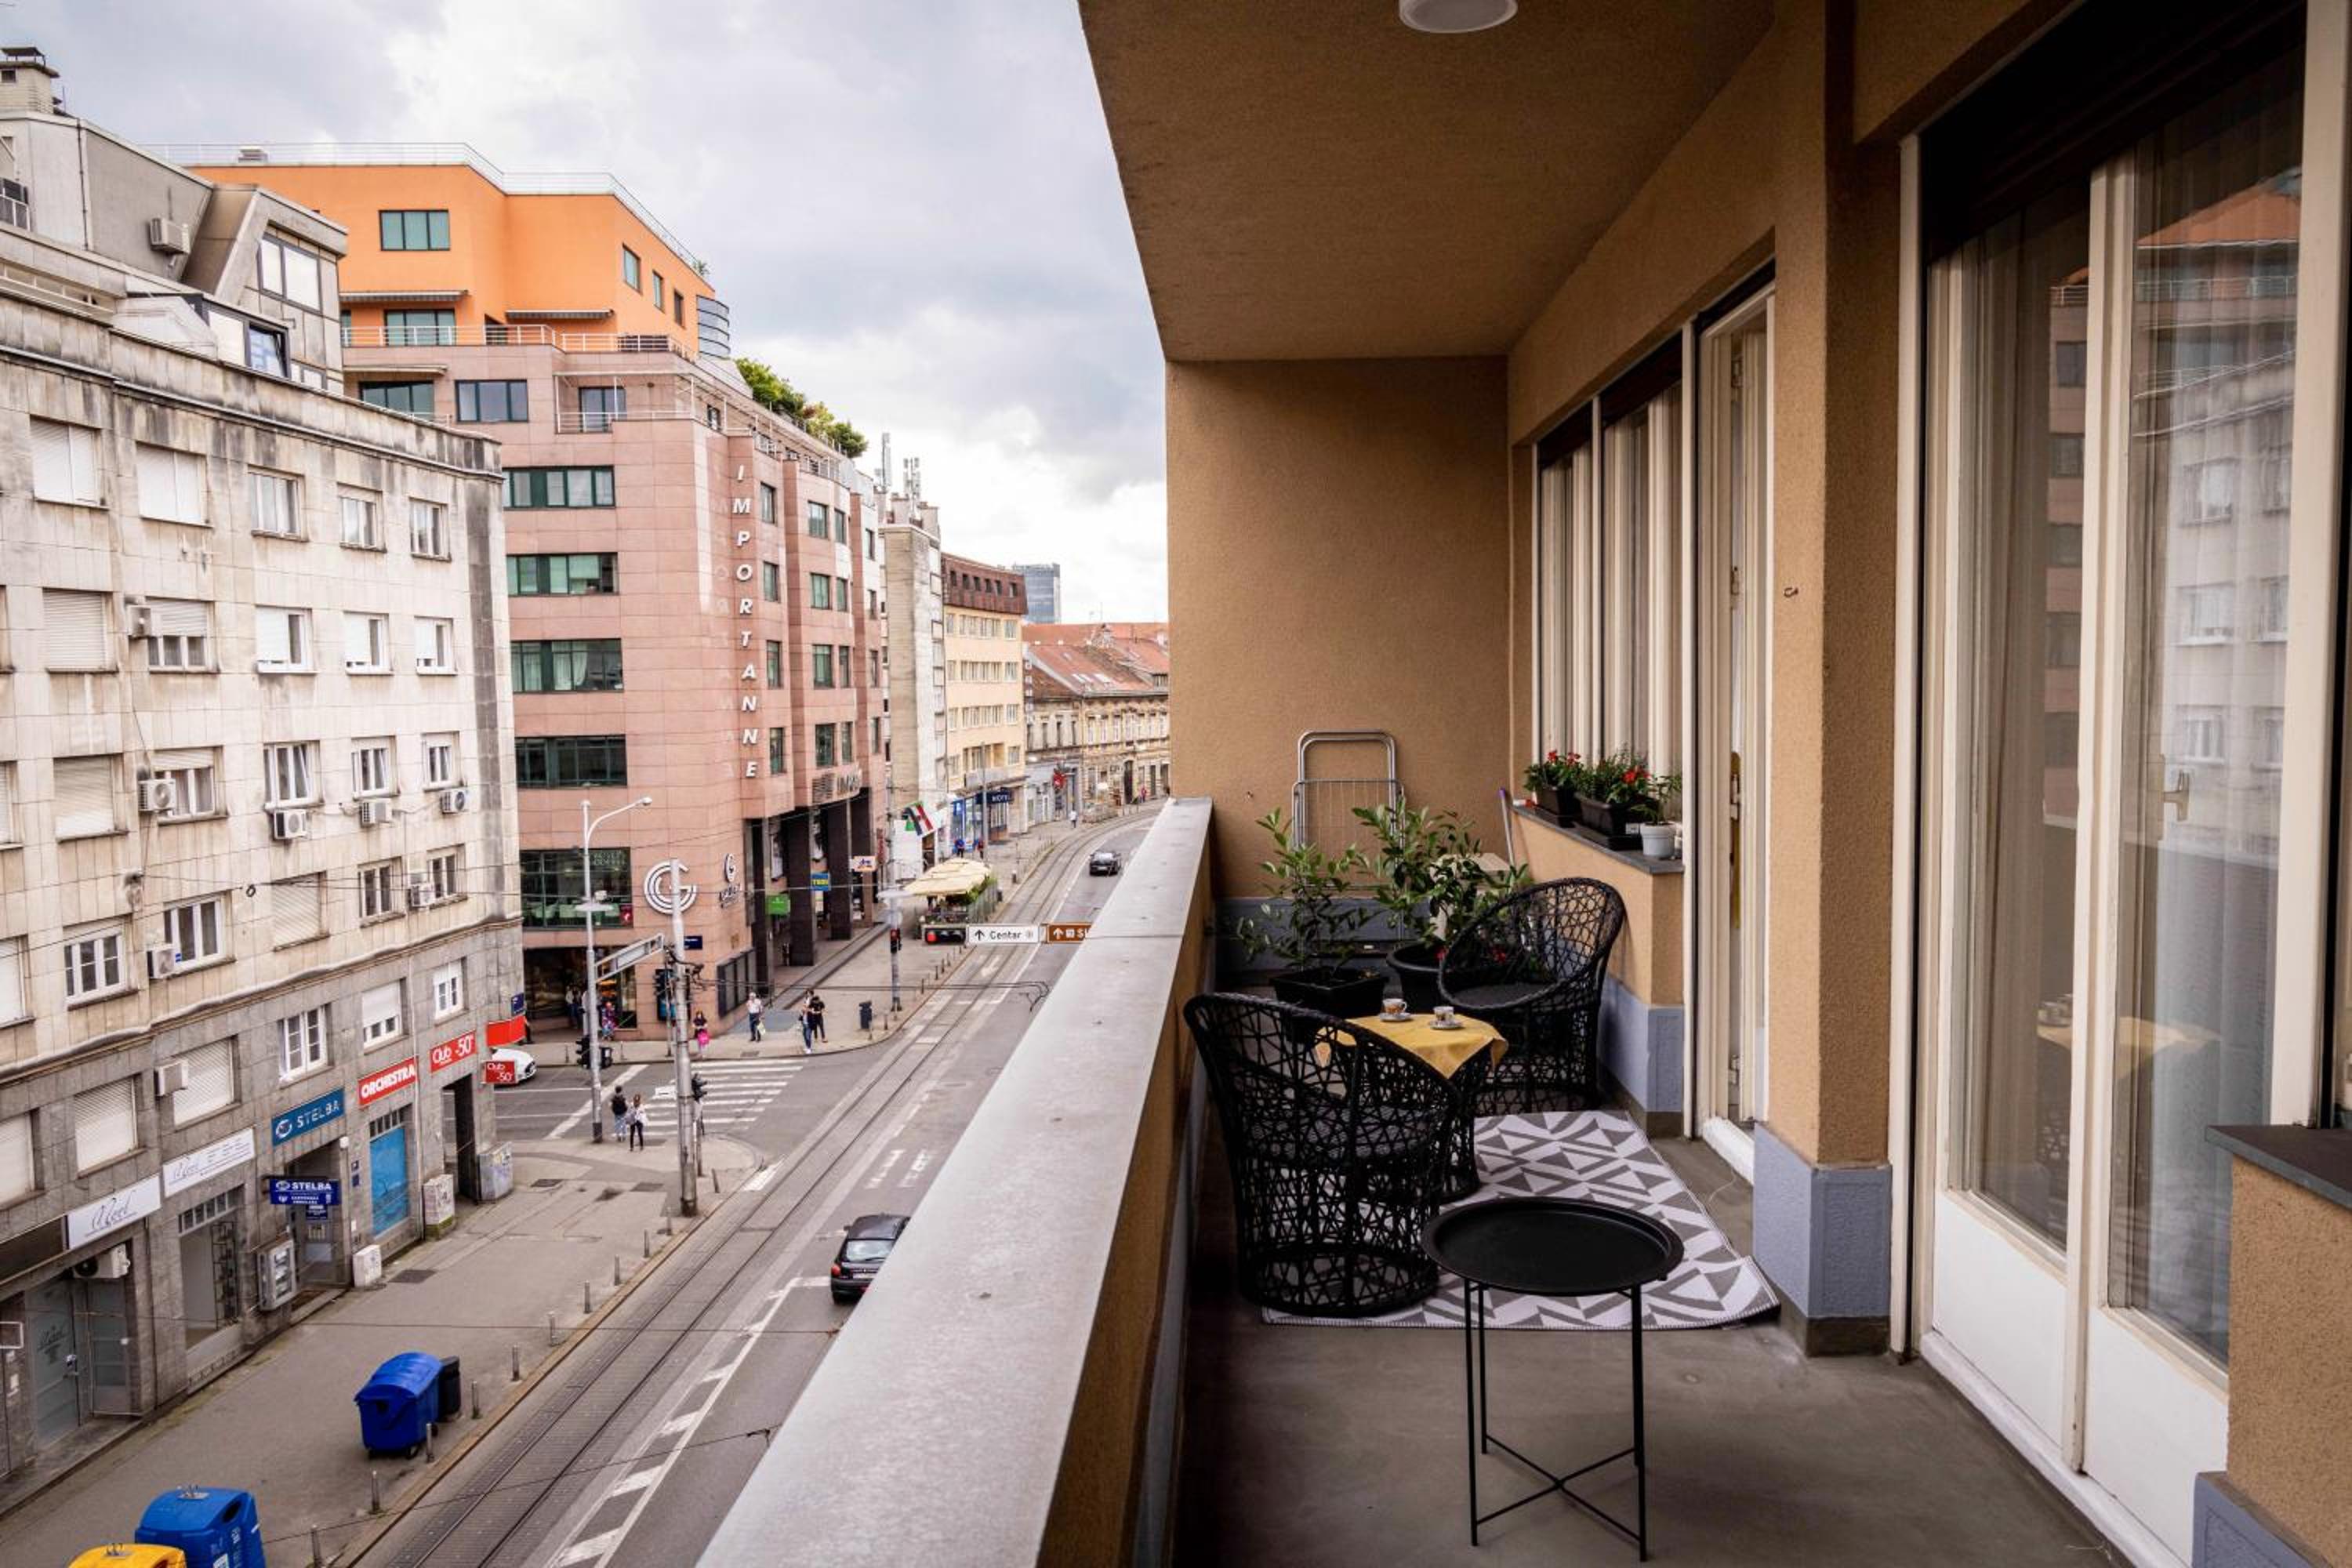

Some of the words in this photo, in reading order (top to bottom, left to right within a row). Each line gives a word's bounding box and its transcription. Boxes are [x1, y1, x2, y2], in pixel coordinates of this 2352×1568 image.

[732, 464, 758, 778] IMPORTANNE
[989, 931, 1022, 940] Centar
[361, 1064, 416, 1098] ORCHESTRA
[297, 1100, 339, 1128] STELBA
[292, 1181, 332, 1190] STELBA
